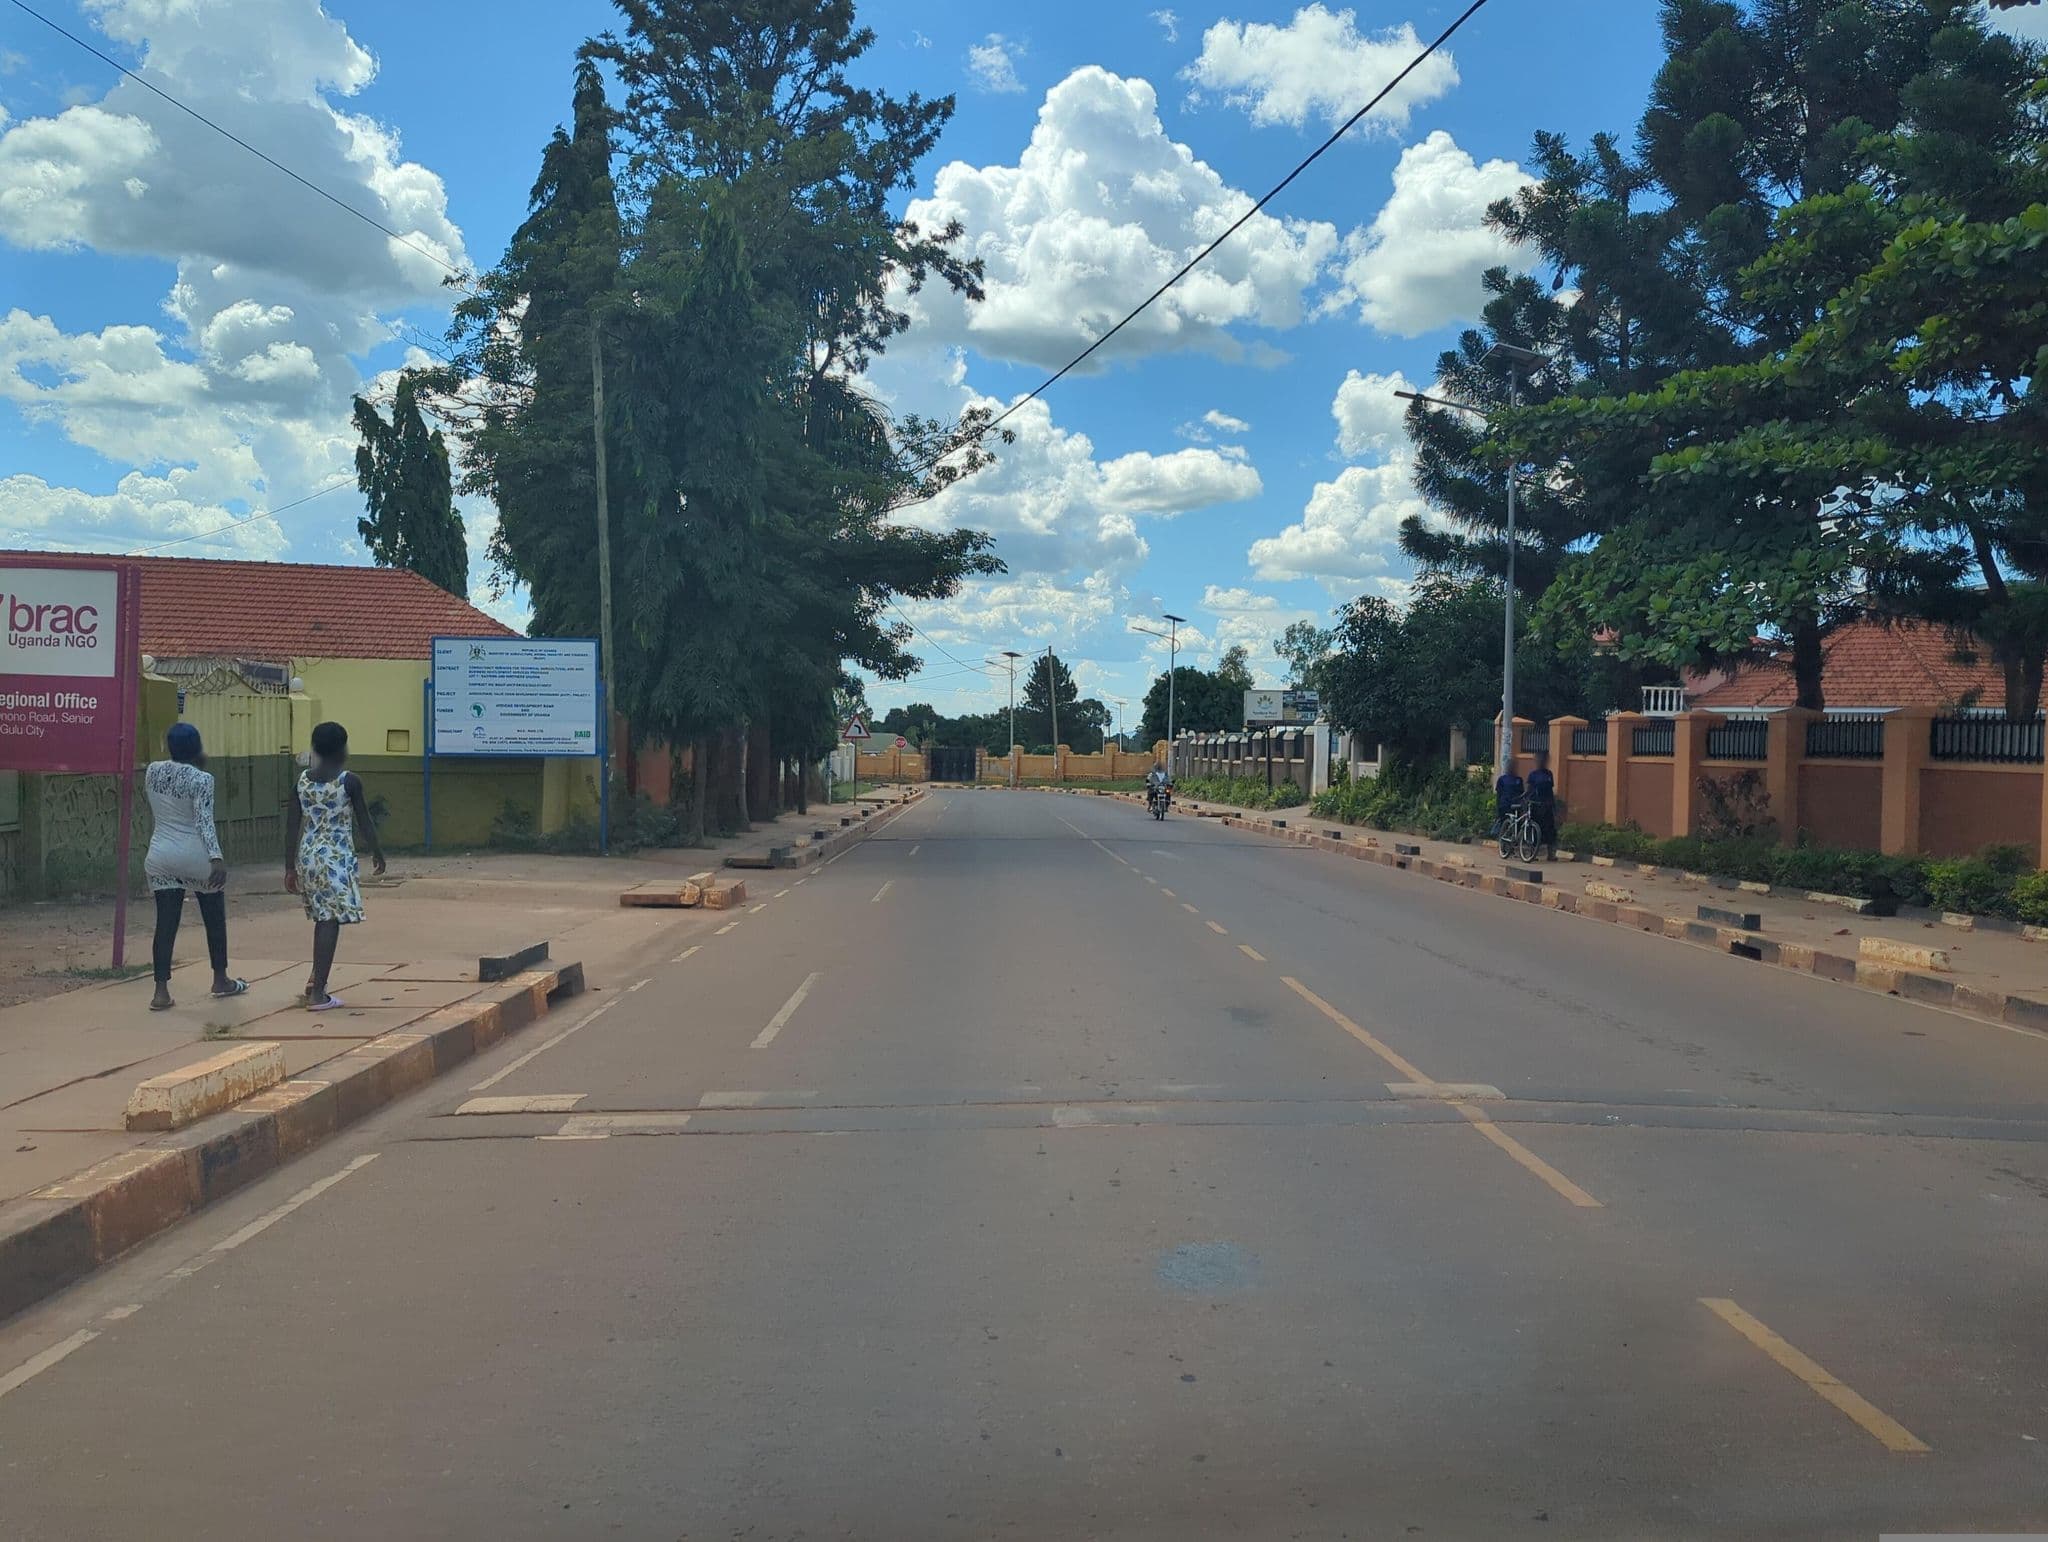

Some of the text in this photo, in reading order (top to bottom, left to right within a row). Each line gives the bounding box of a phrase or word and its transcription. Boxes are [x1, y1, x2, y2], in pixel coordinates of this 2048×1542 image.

[9, 594, 98, 634] brac
[8, 633, 97, 649] Uganda NGO
[54, 692, 98, 709] Office
[28, 711, 59, 723] Road,
[61, 712, 95, 724] Senior
[0, 723, 45, 738] Gulu City
